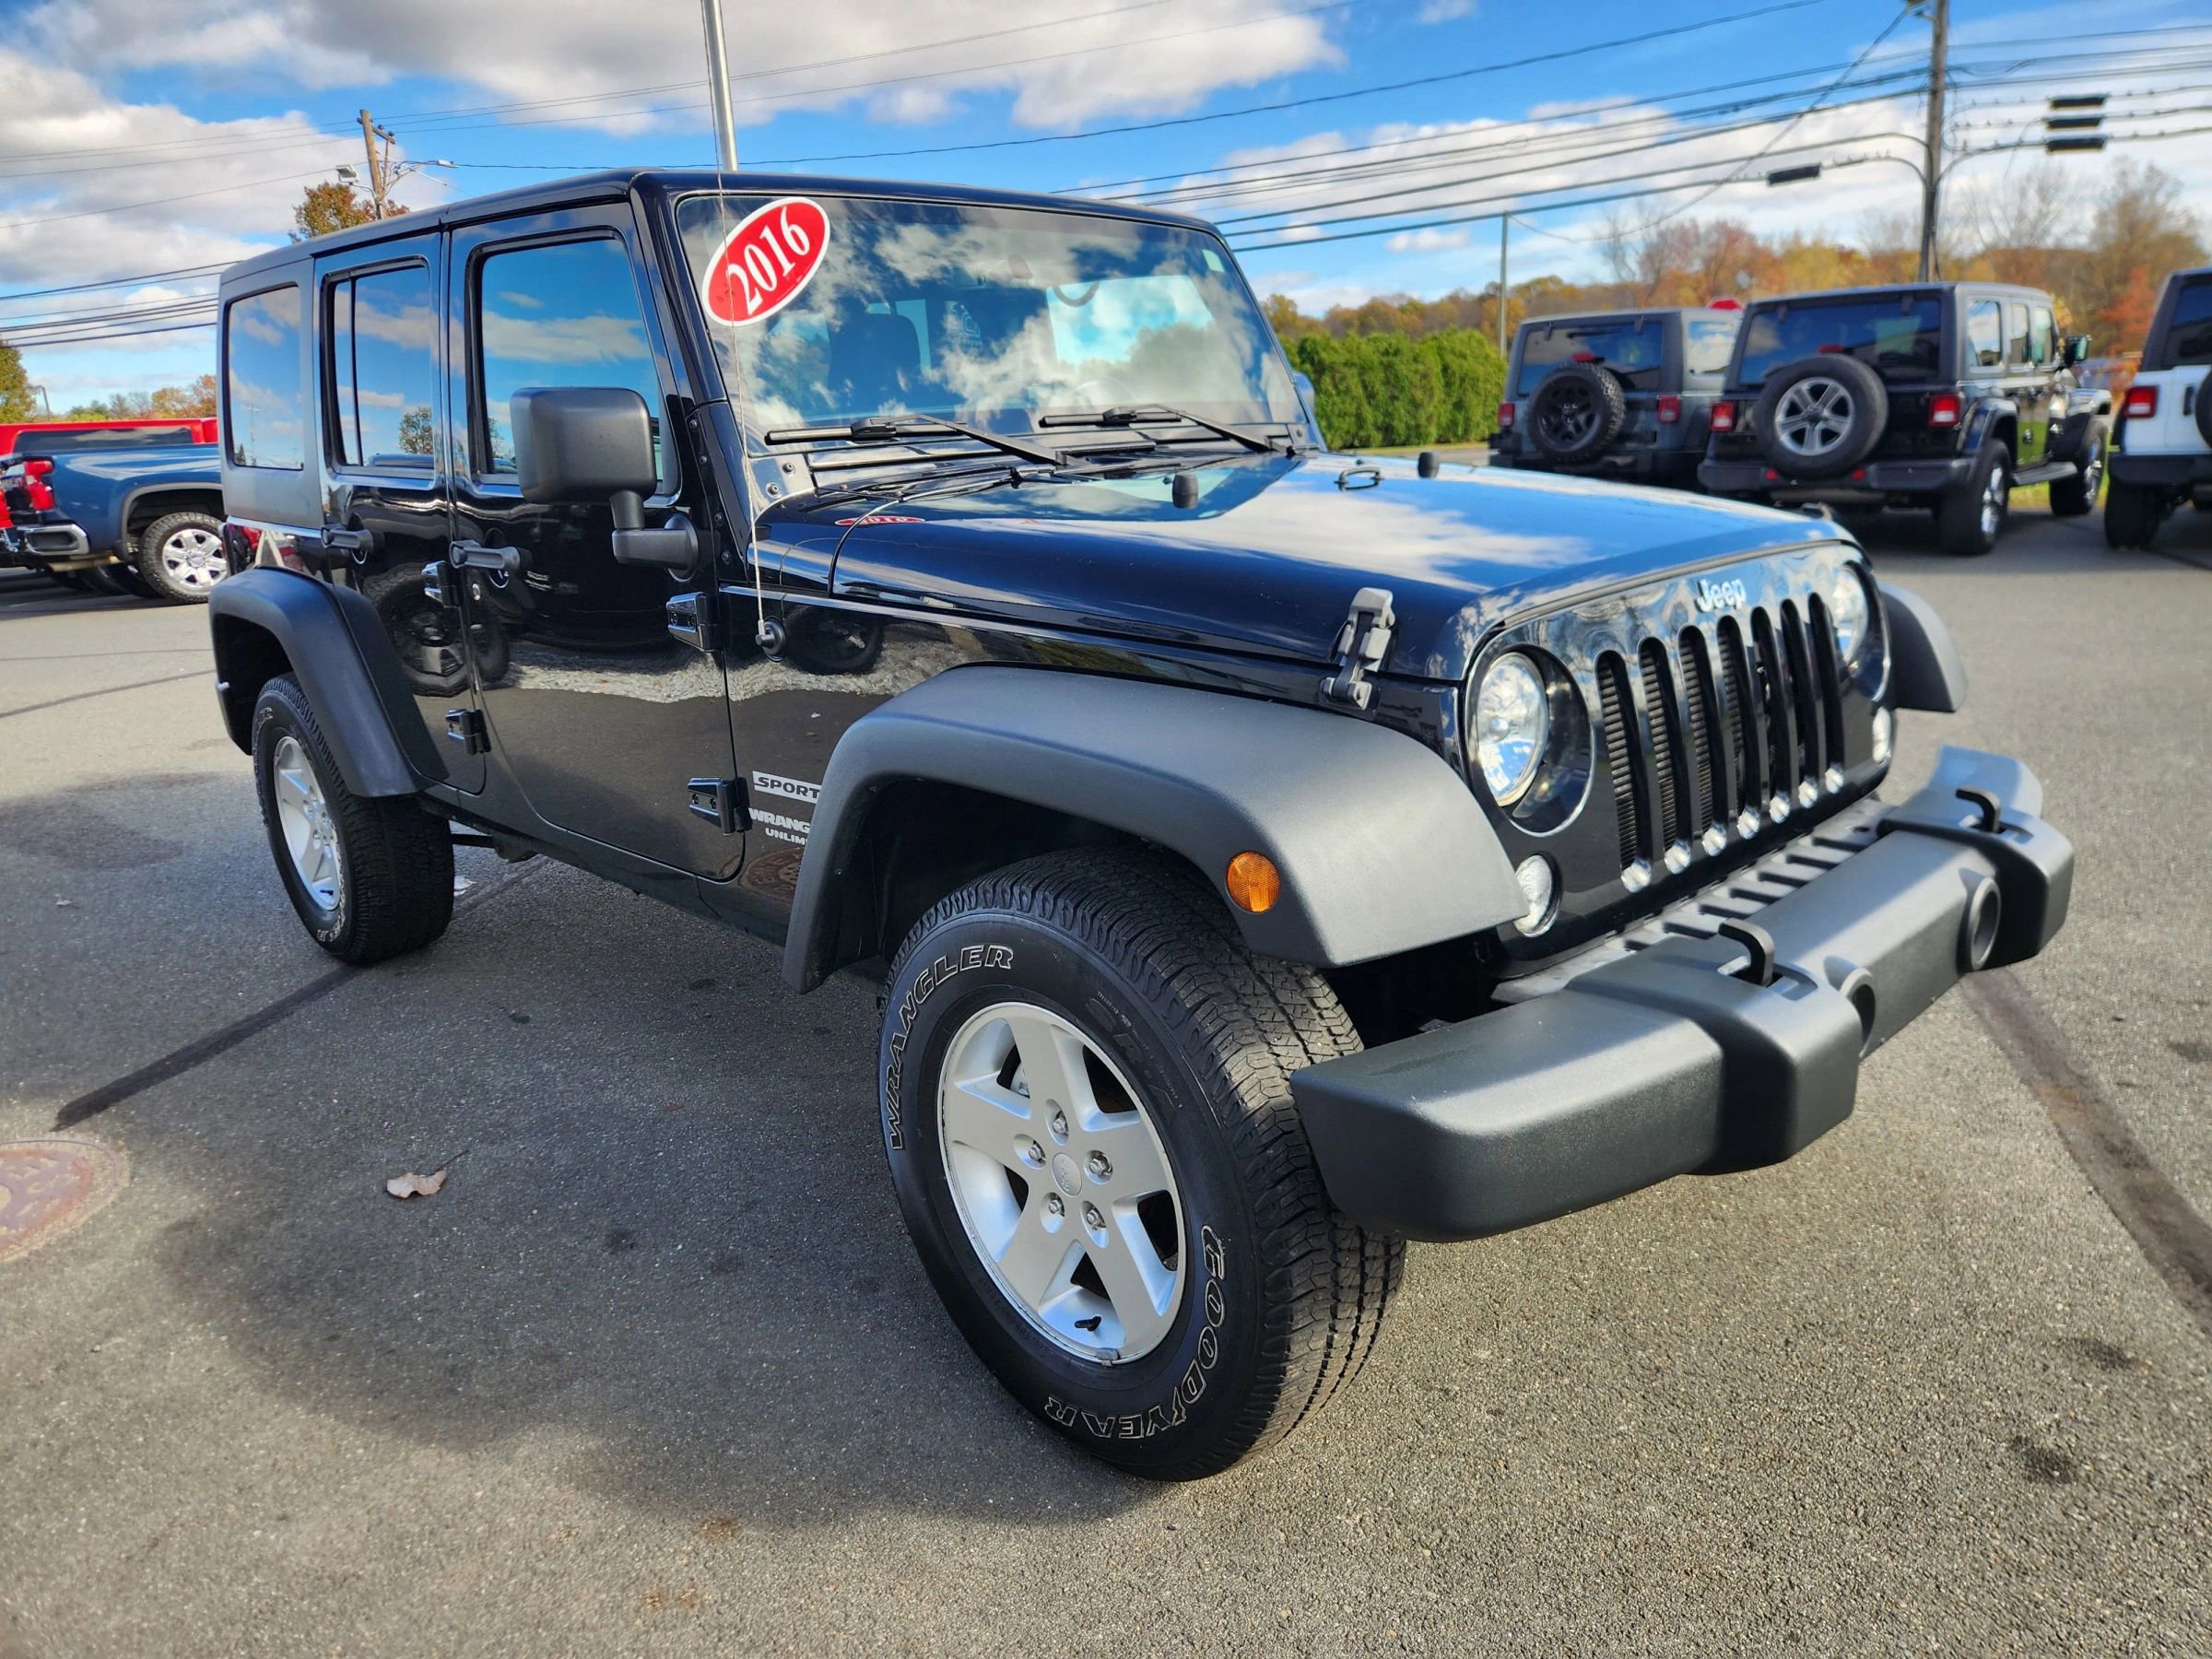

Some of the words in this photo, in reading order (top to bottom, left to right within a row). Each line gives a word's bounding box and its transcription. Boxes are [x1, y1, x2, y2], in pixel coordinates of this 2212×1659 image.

[726, 206, 810, 315] 2016
[1696, 578, 1747, 613] Jeep
[754, 776, 820, 799] SPORT
[887, 945, 1013, 1150] WRANGLER
[1044, 1225, 1225, 1439] GOODYEAR
